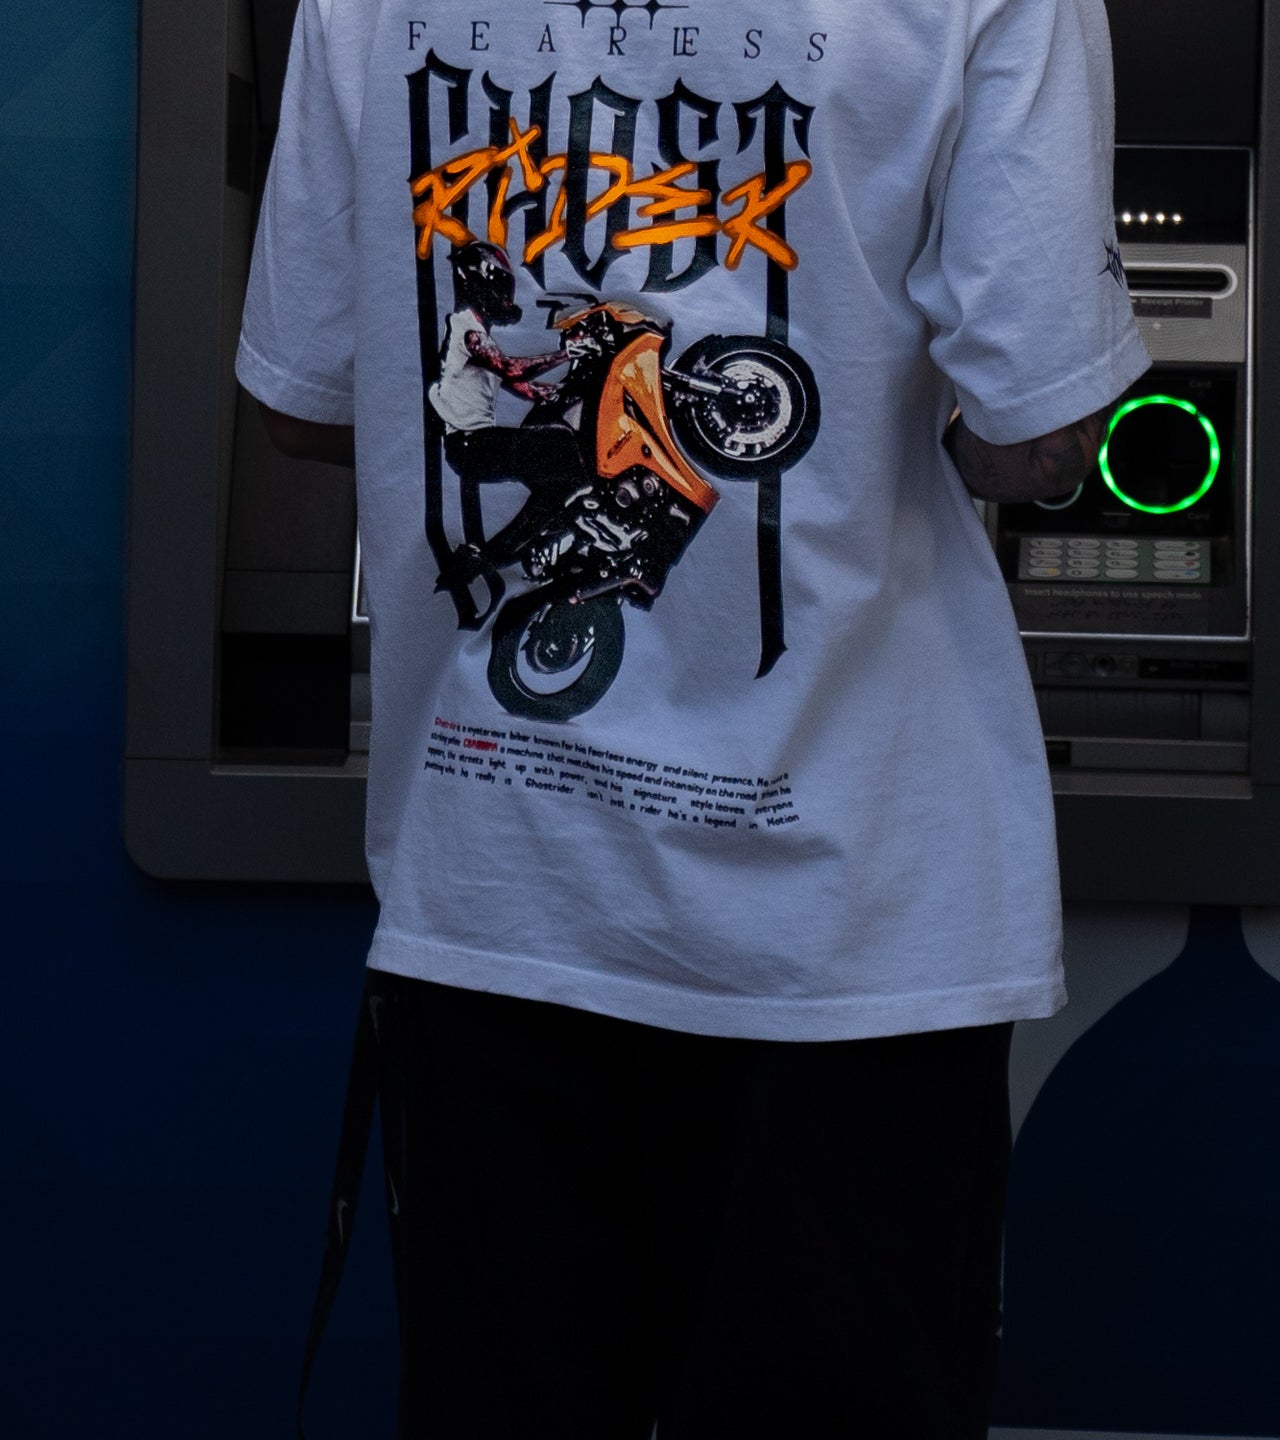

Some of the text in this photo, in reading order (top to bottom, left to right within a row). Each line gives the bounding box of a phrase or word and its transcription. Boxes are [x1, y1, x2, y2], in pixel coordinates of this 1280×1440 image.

[407, 20, 827, 62] FEARLESS
[411, 116, 813, 270] RIDER
[1024, 588, 1050, 597] Insert
[1052, 588, 1108, 599] headphones
[1141, 591, 1174, 600] speech
[1176, 591, 1202, 600] mode
[459, 755, 484, 765] streets
[489, 758, 506, 770] light
[515, 764, 526, 775] up
[534, 765, 554, 776] with
[560, 771, 588, 784] power,
[610, 782, 623, 792] his
[633, 788, 677, 803] signature
[691, 799, 713, 810] style
[715, 802, 745, 815] leaves
[468, 726, 506, 739] mysterious
[533, 735, 560, 747] known
[561, 740, 573, 750] for
[575, 744, 586, 754] his
[588, 746, 624, 763] fearless
[626, 757, 658, 772] energy
[663, 764, 681, 775] and
[682, 768, 709, 780] silent
[712, 774, 755, 787] presence.
[756, 777, 769, 787] He
[507, 747, 544, 759] machine
[547, 752, 564, 764] that
[566, 758, 600, 772] matches
[602, 764, 614, 776] his
[616, 769, 644, 781] speed
[644, 775, 662, 785] and
[663, 778, 704, 795] intensity
[705, 788, 717, 796] on
[718, 788, 734, 799] the
[735, 791, 758, 801] road
[780, 786, 792, 795] he
[460, 768, 469, 778] he
[475, 772, 496, 784] really
[504, 777, 512, 786] is
[525, 777, 575, 794] Ghostrider
[629, 803, 635, 811] a
[640, 804, 662, 816] rider
[667, 809, 687, 821] he's
[704, 815, 737, 829] legend
[749, 822, 758, 830] in
[766, 813, 800, 827] Motion
